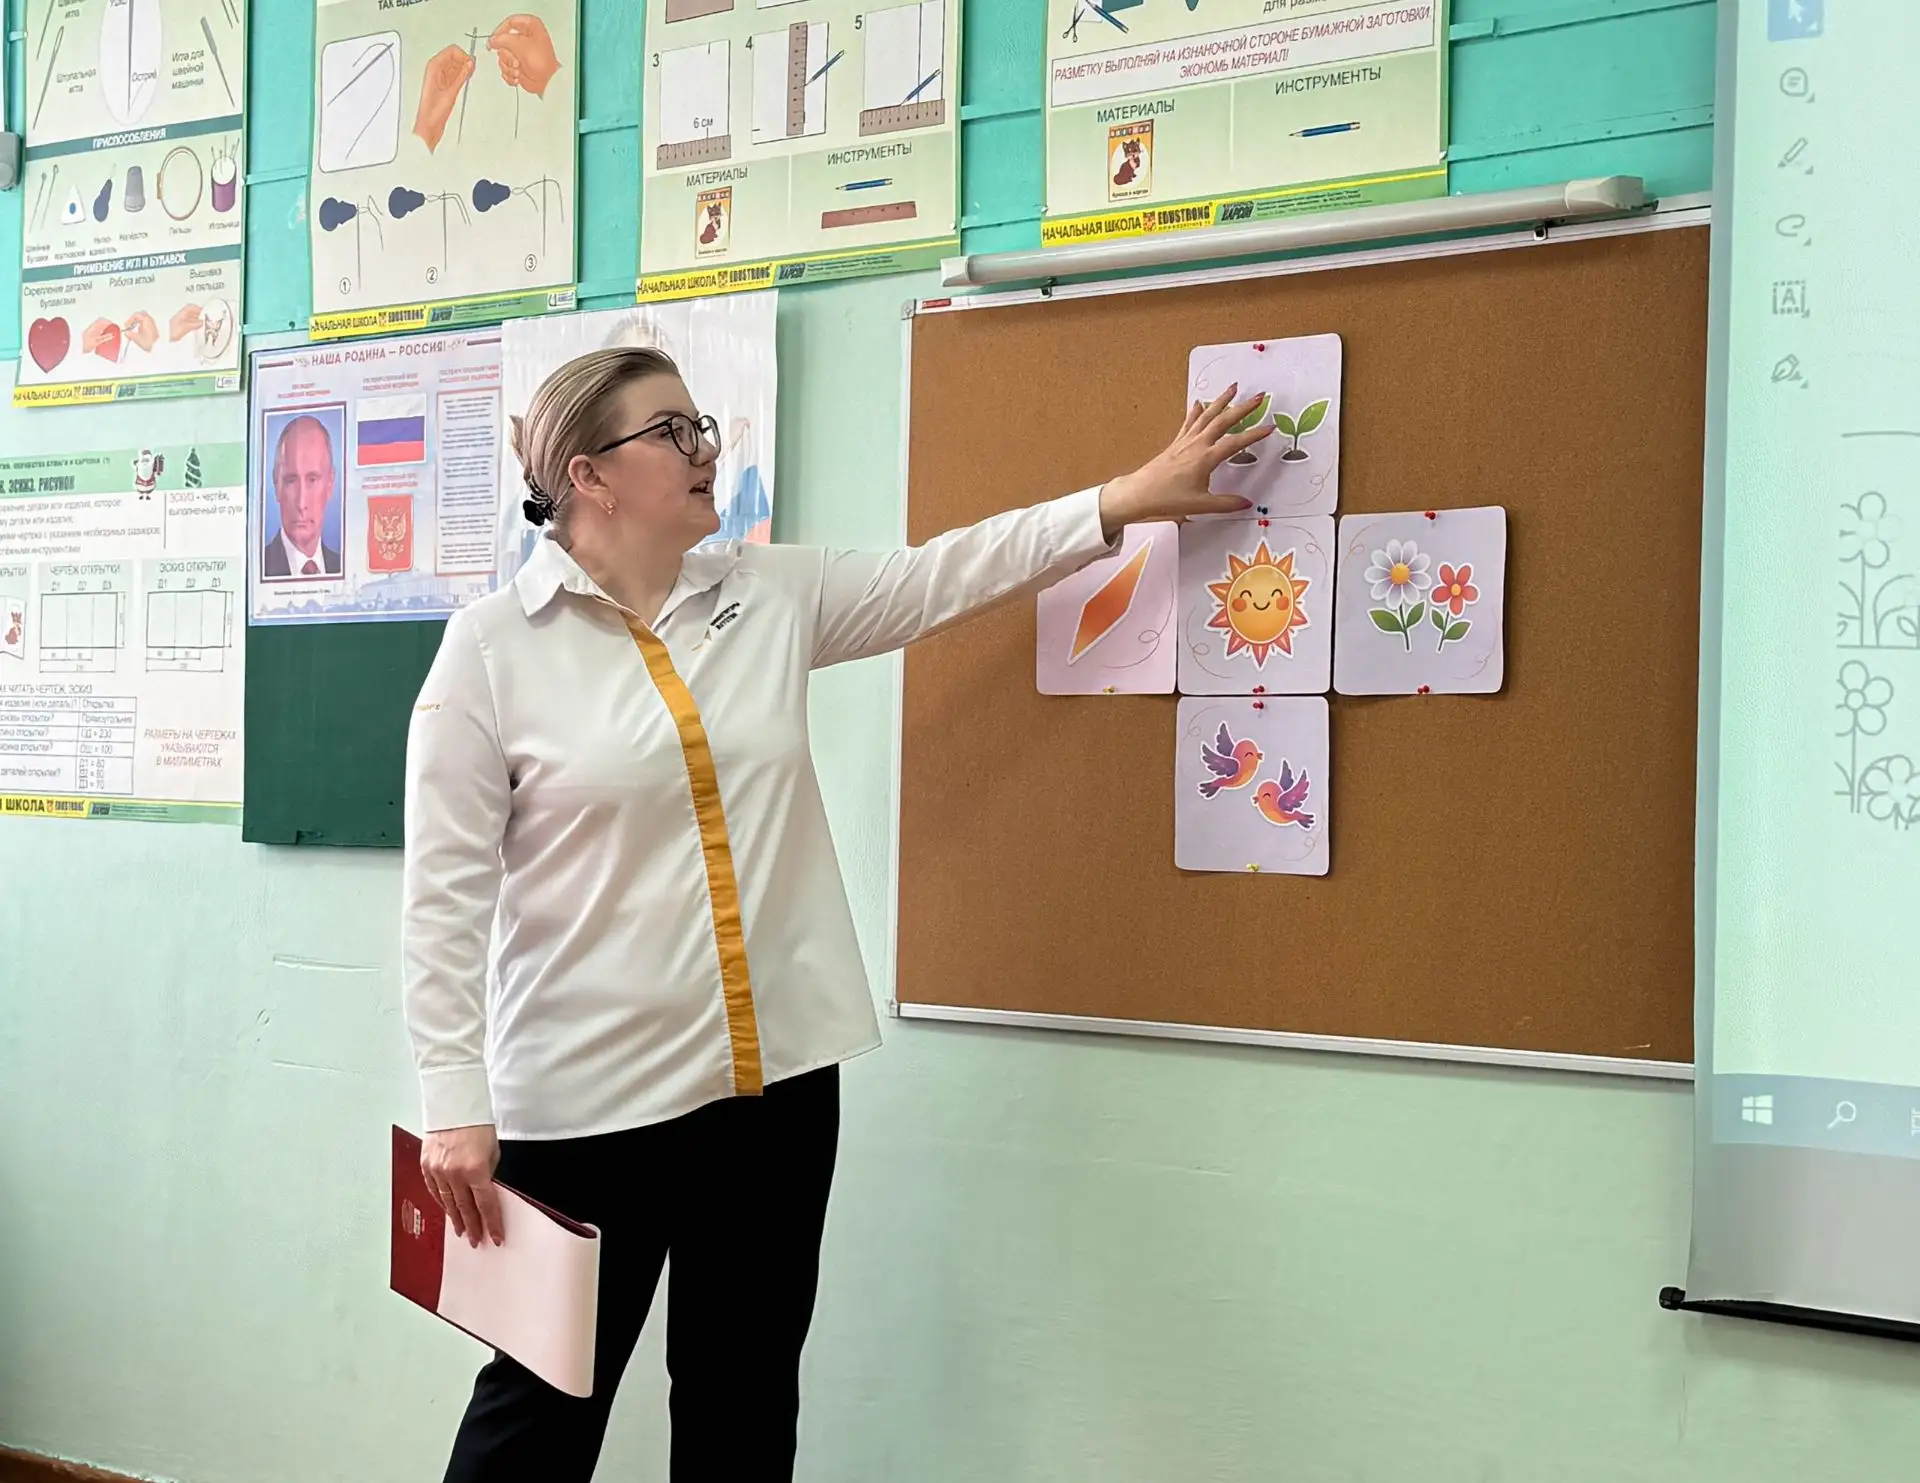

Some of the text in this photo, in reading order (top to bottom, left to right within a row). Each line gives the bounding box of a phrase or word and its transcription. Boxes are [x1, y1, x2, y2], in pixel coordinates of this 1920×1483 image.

[1263, 0, 1286, 14] для
[855, 14, 862, 30] 5
[745, 36, 753, 50] 4
[1054, 62, 1104, 81] РАЗМЕТКУ
[1105, 50, 1161, 75] ВЫПОЛНЯЙ
[1162, 50, 1176, 62] НА
[1177, 34, 1248, 61] ИЗНАНОЧНОЙ
[1249, 28, 1300, 49] СТОРОНЕ
[1301, 15, 1364, 41] БУМАЖНОЙ
[172, 52, 189, 62] Игла
[652, 52, 660, 67] 3
[1180, 48, 1290, 80] ЭКОНОМЬ МАТЕРИАЛ!
[1275, 66, 1381, 96] ИНСТРУМЕНТЫ
[1097, 98, 1175, 123] МАТЕРИАЛЫ
[693, 116, 714, 129] 6 см
[92, 128, 166, 149] ПРИСПОСОБЛЕНИЯ
[827, 141, 912, 165] ИНСТРУМЕНТЫ
[686, 167, 749, 187] МАТЕРИАЛЫ
[1158, 205, 1210, 225] EDUSTRONG
[1042, 221, 1103, 241] НАЧАЛЬНАЯ
[1104, 216, 1142, 233] ШКОЛА
[73, 252, 187, 276] ПРИМЕНЕНИЕ ИГЛ И БУЛАВОК
[637, 278, 686, 295] НАЧАЛЬНАЯ
[687, 275, 717, 290] ШКОЛА
[310, 316, 378, 332] НАЧАЛЬНАЯ ШКОЛА
[311, 352, 341, 367] НАША
[344, 348, 386, 363] РОДИНА
[398, 340, 447, 357] РОССИЯ!
[39, 475, 75, 492] РИСУНОК
[5, 798, 45, 813] ШКОЛА
